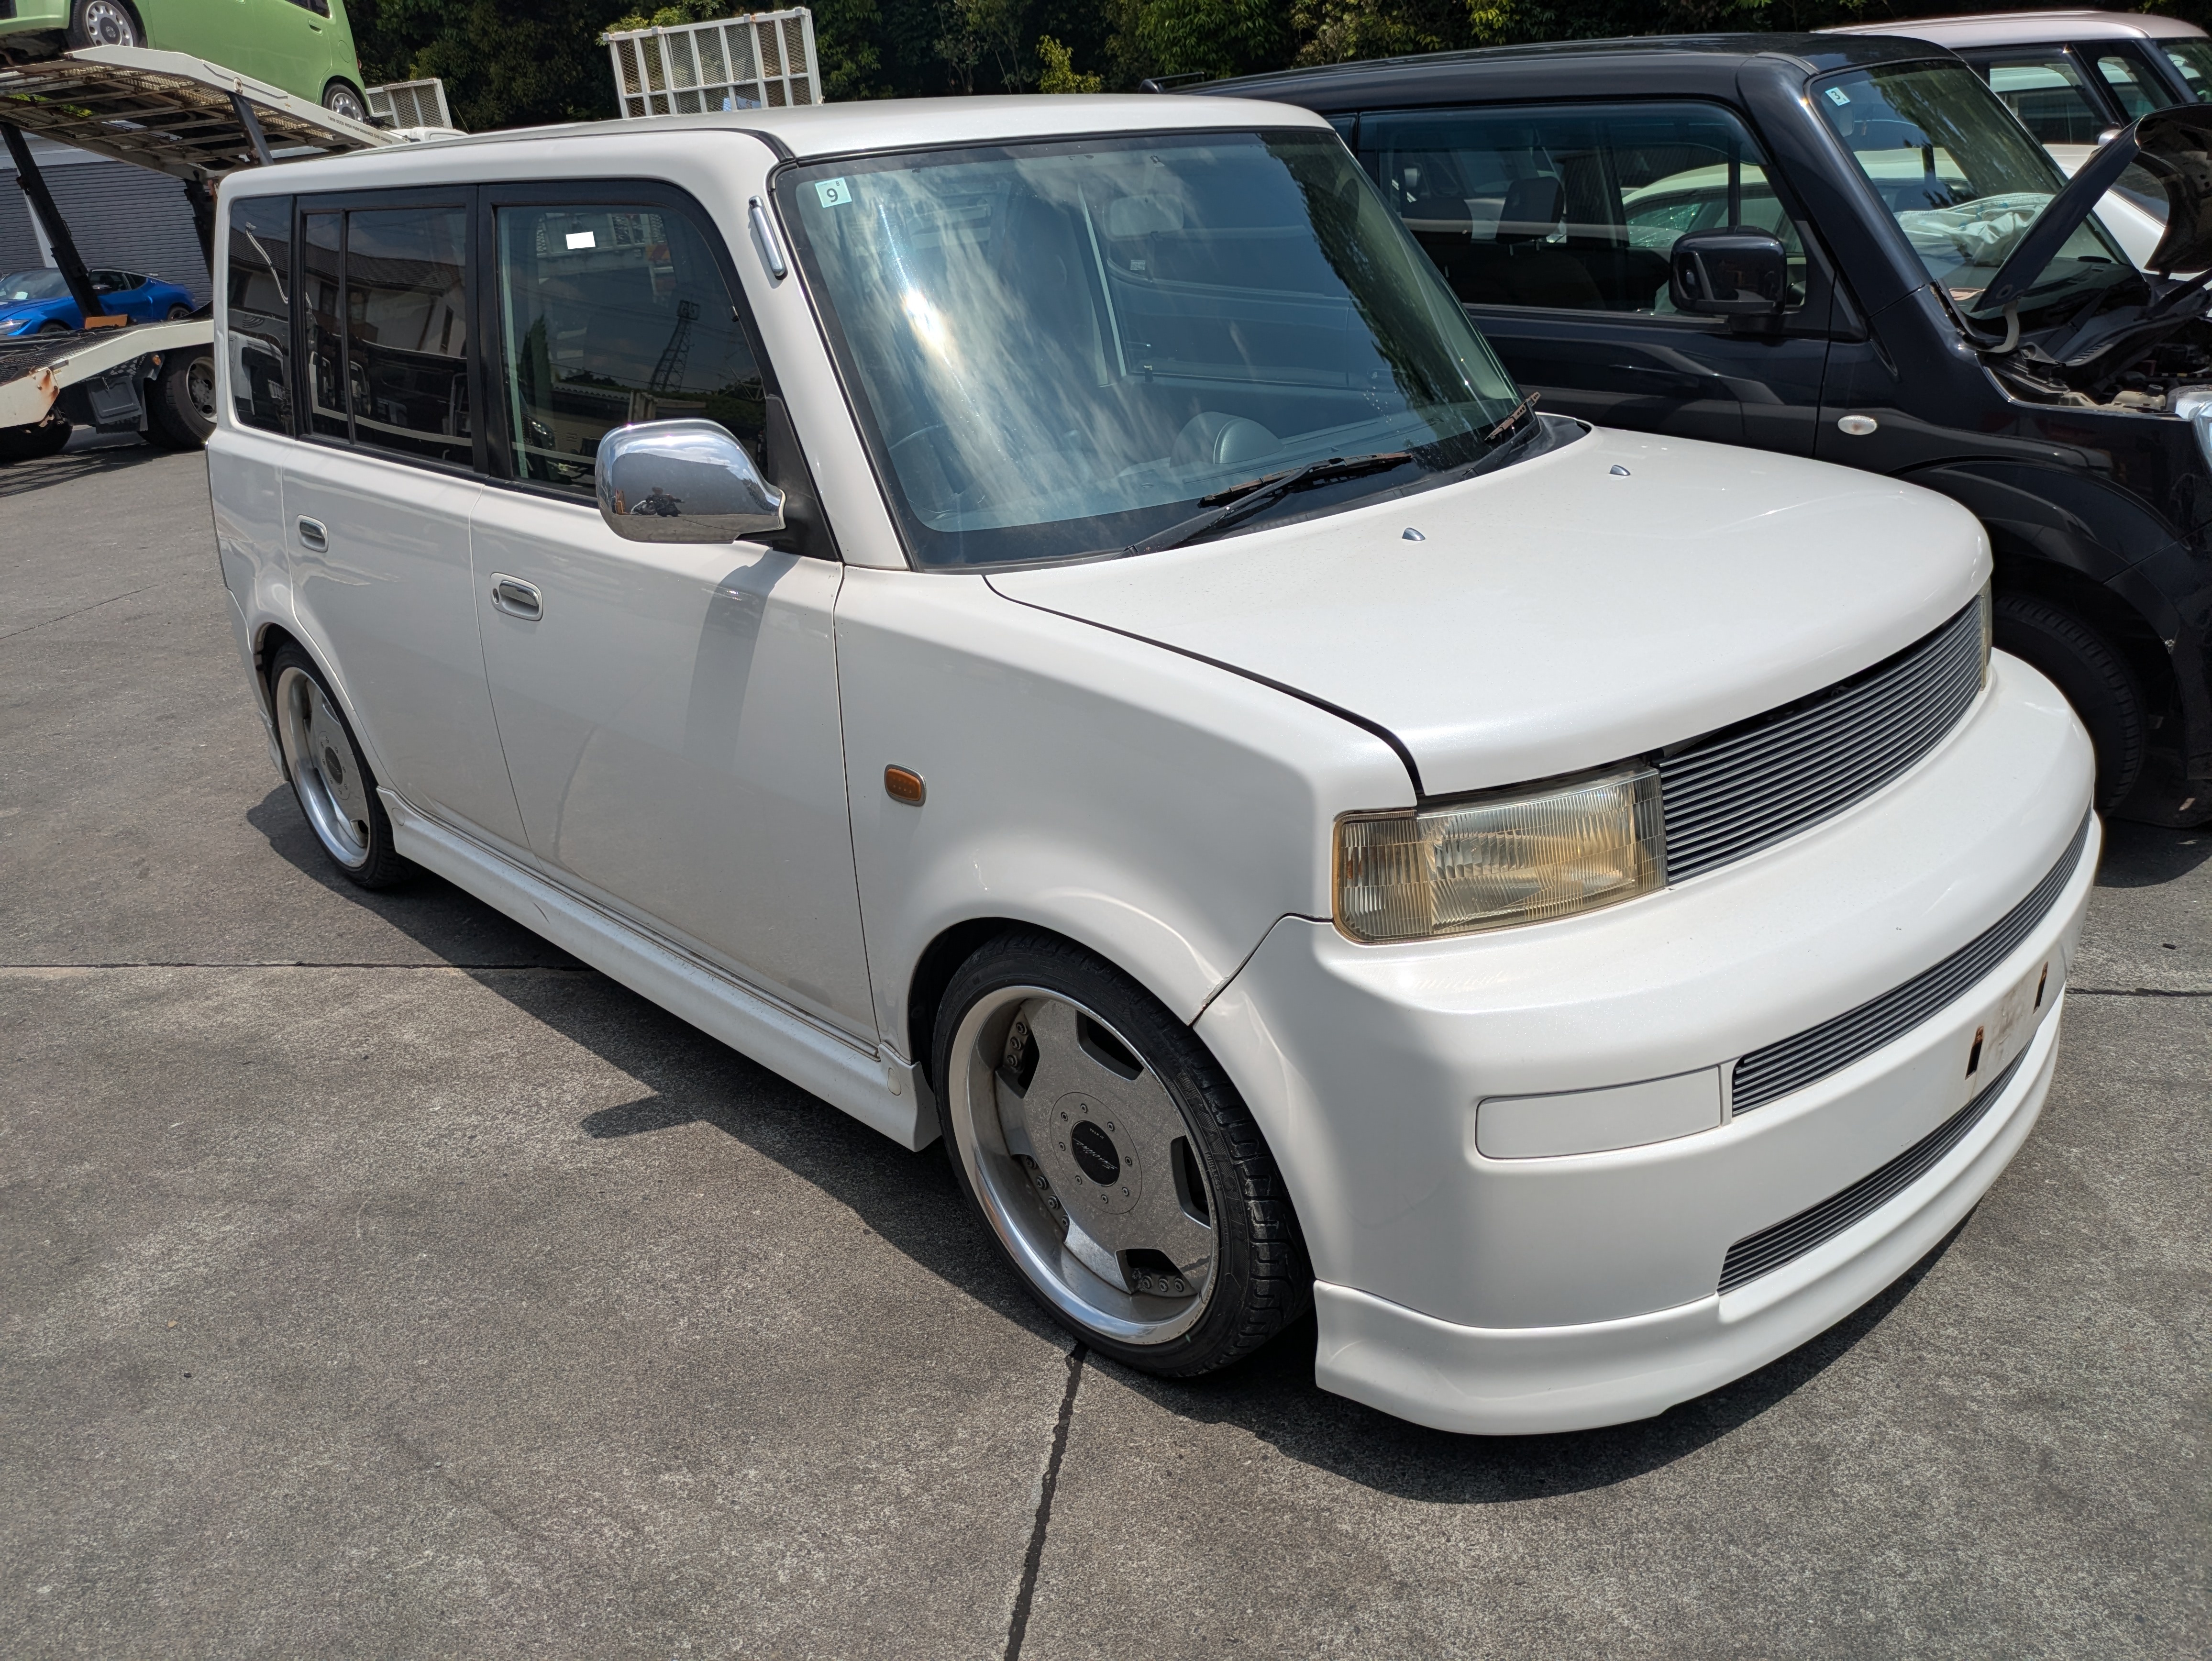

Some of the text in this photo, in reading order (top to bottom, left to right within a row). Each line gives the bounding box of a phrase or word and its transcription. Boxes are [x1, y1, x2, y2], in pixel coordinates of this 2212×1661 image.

[1831, 91, 1840, 100] 3
[353, 125, 374, 137] PERFORMANCE
[380, 136, 393, 144] CARRIER
[826, 188, 838, 203] 9
[1187, 1096, 1246, 1241] KAISER
[1204, 1150, 1222, 1192] TUBELESS
